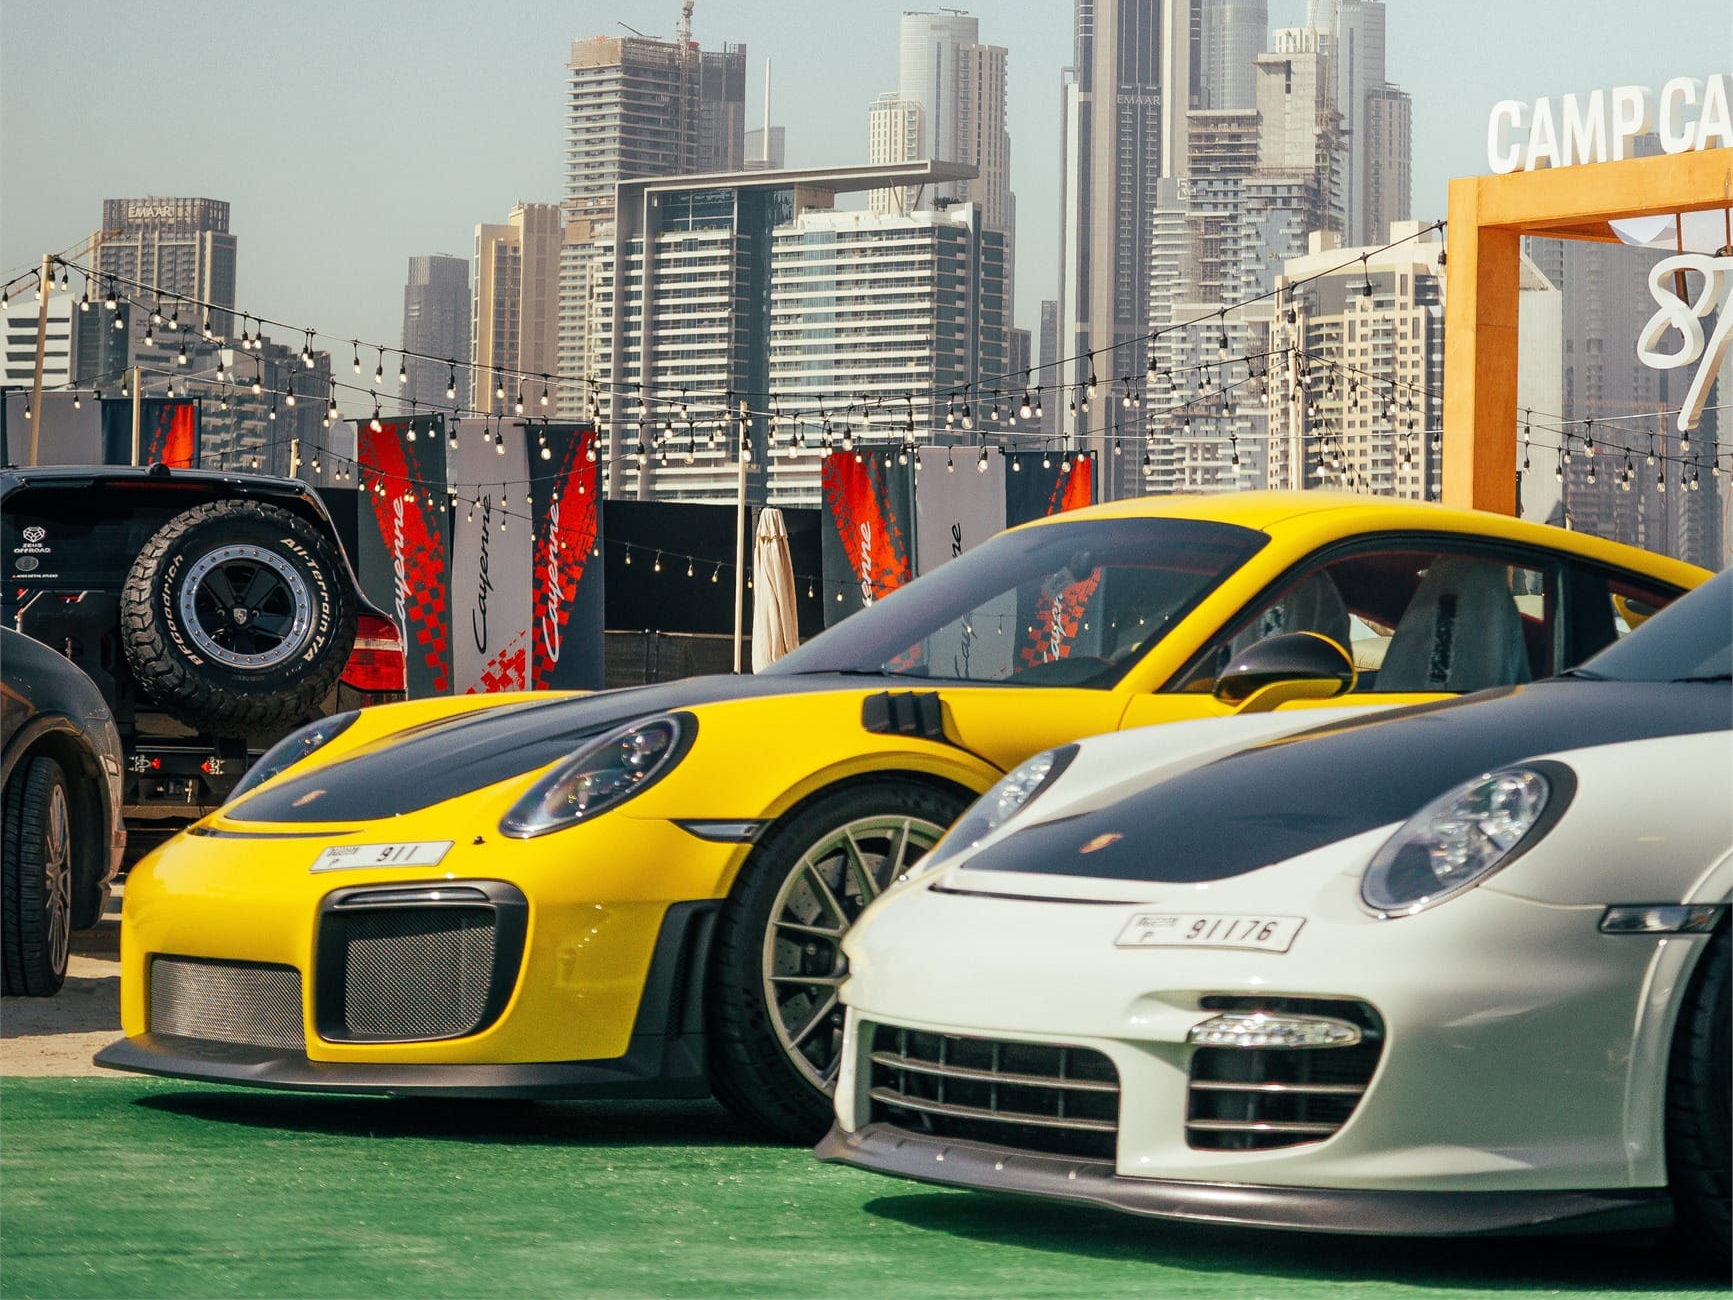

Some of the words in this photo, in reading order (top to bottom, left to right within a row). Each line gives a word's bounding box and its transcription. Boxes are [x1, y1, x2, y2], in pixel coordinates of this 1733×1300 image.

[1117, 94, 1160, 105] EMAAR
[1488, 86, 1650, 174] CAMP
[1659, 72, 1733, 154] CA
[128, 205, 173, 218] EMAAR
[162, 555, 204, 665] BFGoodrich
[280, 538, 330, 632] All-Terrain
[473, 494, 493, 654] Cayenne
[542, 502, 564, 663] Cayenne
[376, 846, 419, 862] 911
[1186, 919, 1277, 941] 91176
